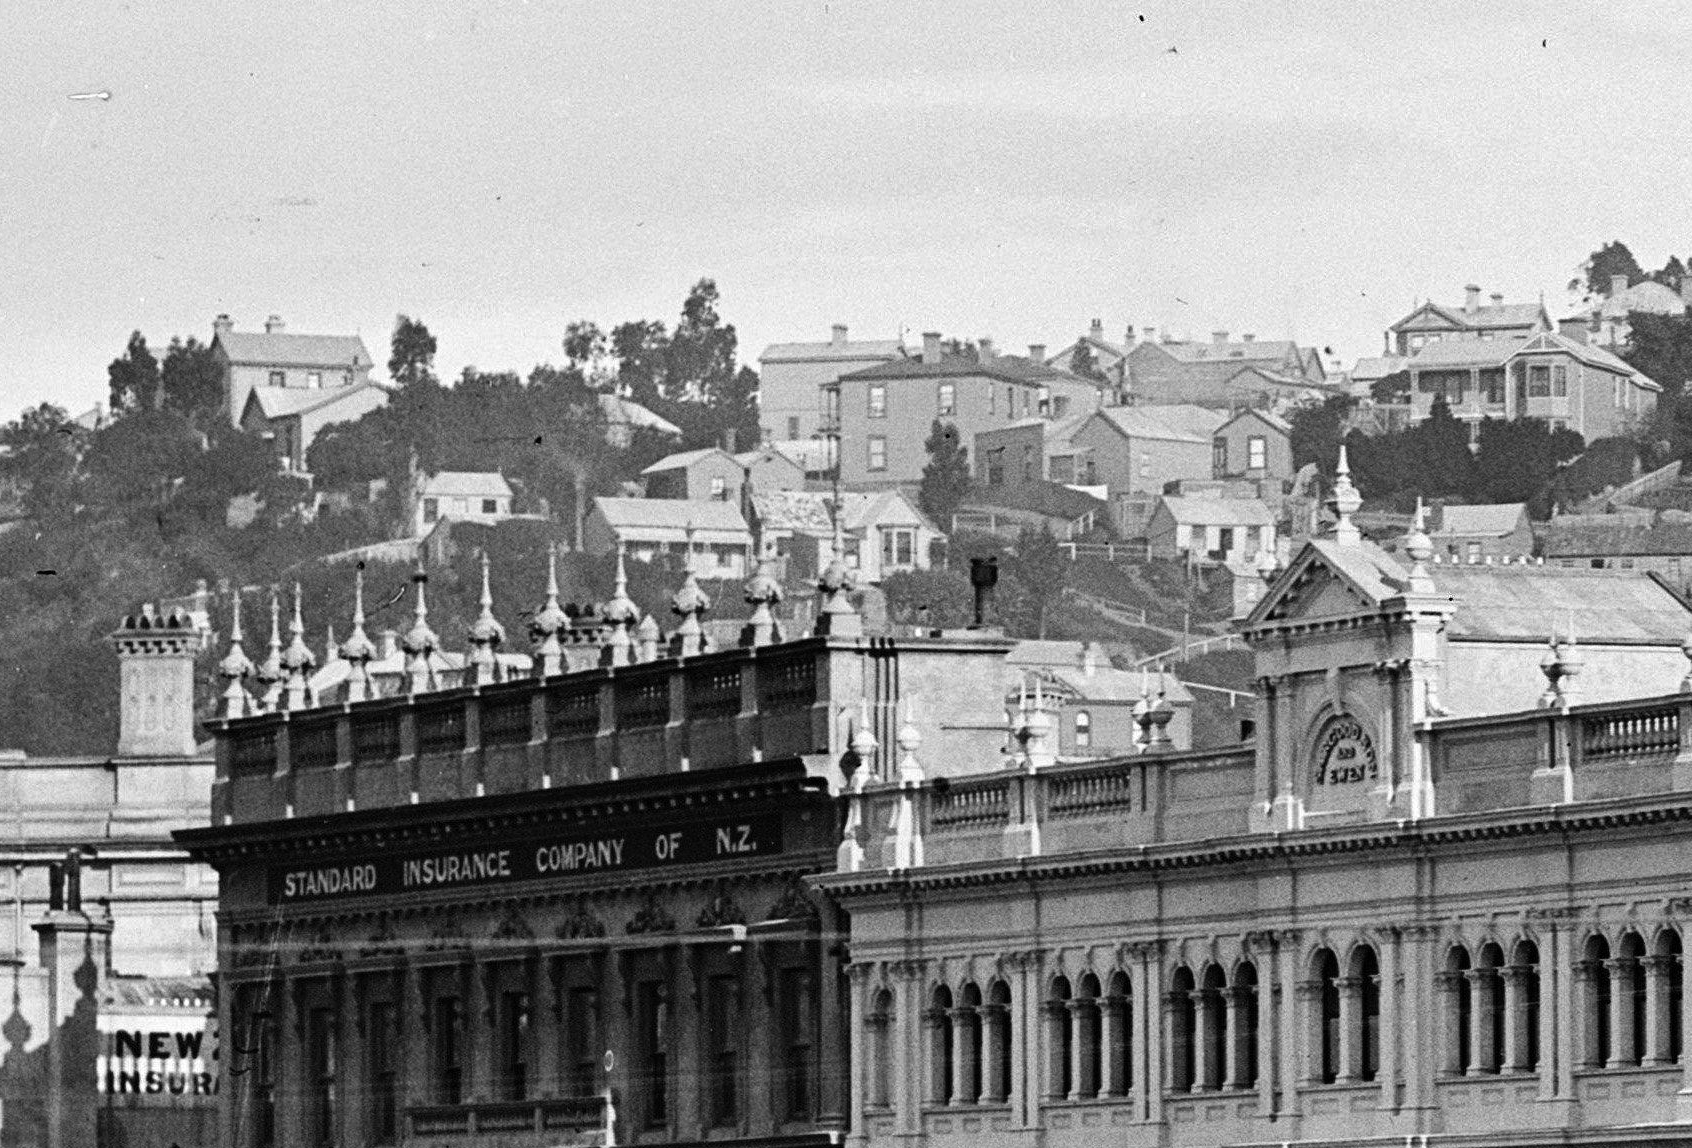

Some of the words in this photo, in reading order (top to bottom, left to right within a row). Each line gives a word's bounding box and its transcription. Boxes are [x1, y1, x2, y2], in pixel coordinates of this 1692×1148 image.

[284, 864, 377, 898] STANDARD
[403, 850, 511, 886] INSURANCE
[536, 838, 625, 872] COMPANY
[655, 832, 683, 860] OF
[715, 824, 758, 855] N.Z.
[115, 1029, 204, 1060] NEW
